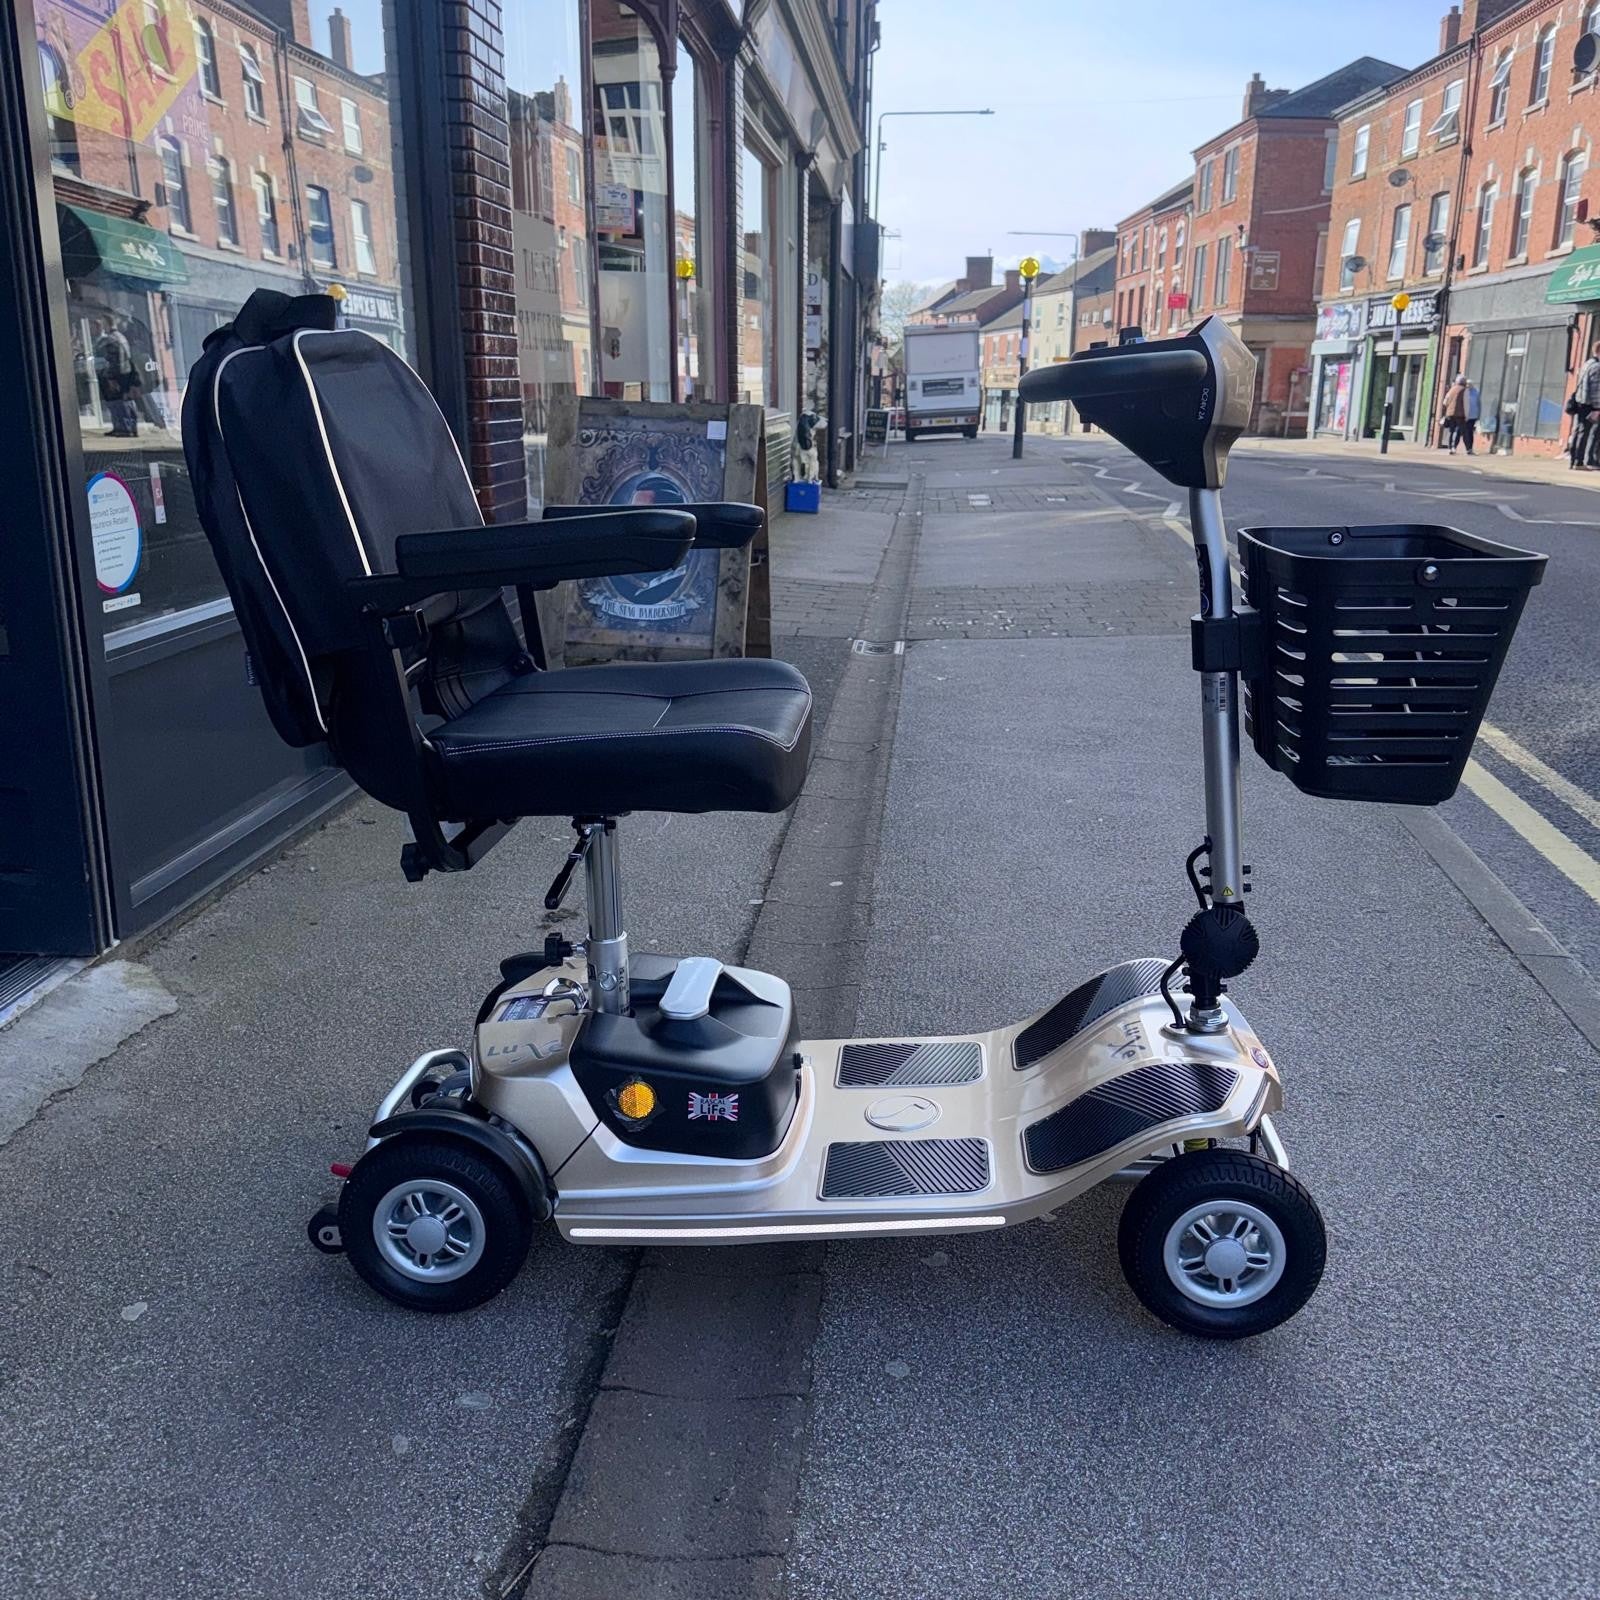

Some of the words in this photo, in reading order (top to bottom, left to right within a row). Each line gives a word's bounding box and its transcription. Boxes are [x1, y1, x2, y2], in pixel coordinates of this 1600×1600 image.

[603, 601, 616, 613] THE
[619, 605, 637, 617] STAG
[639, 602, 684, 619] BARBERSHOP
